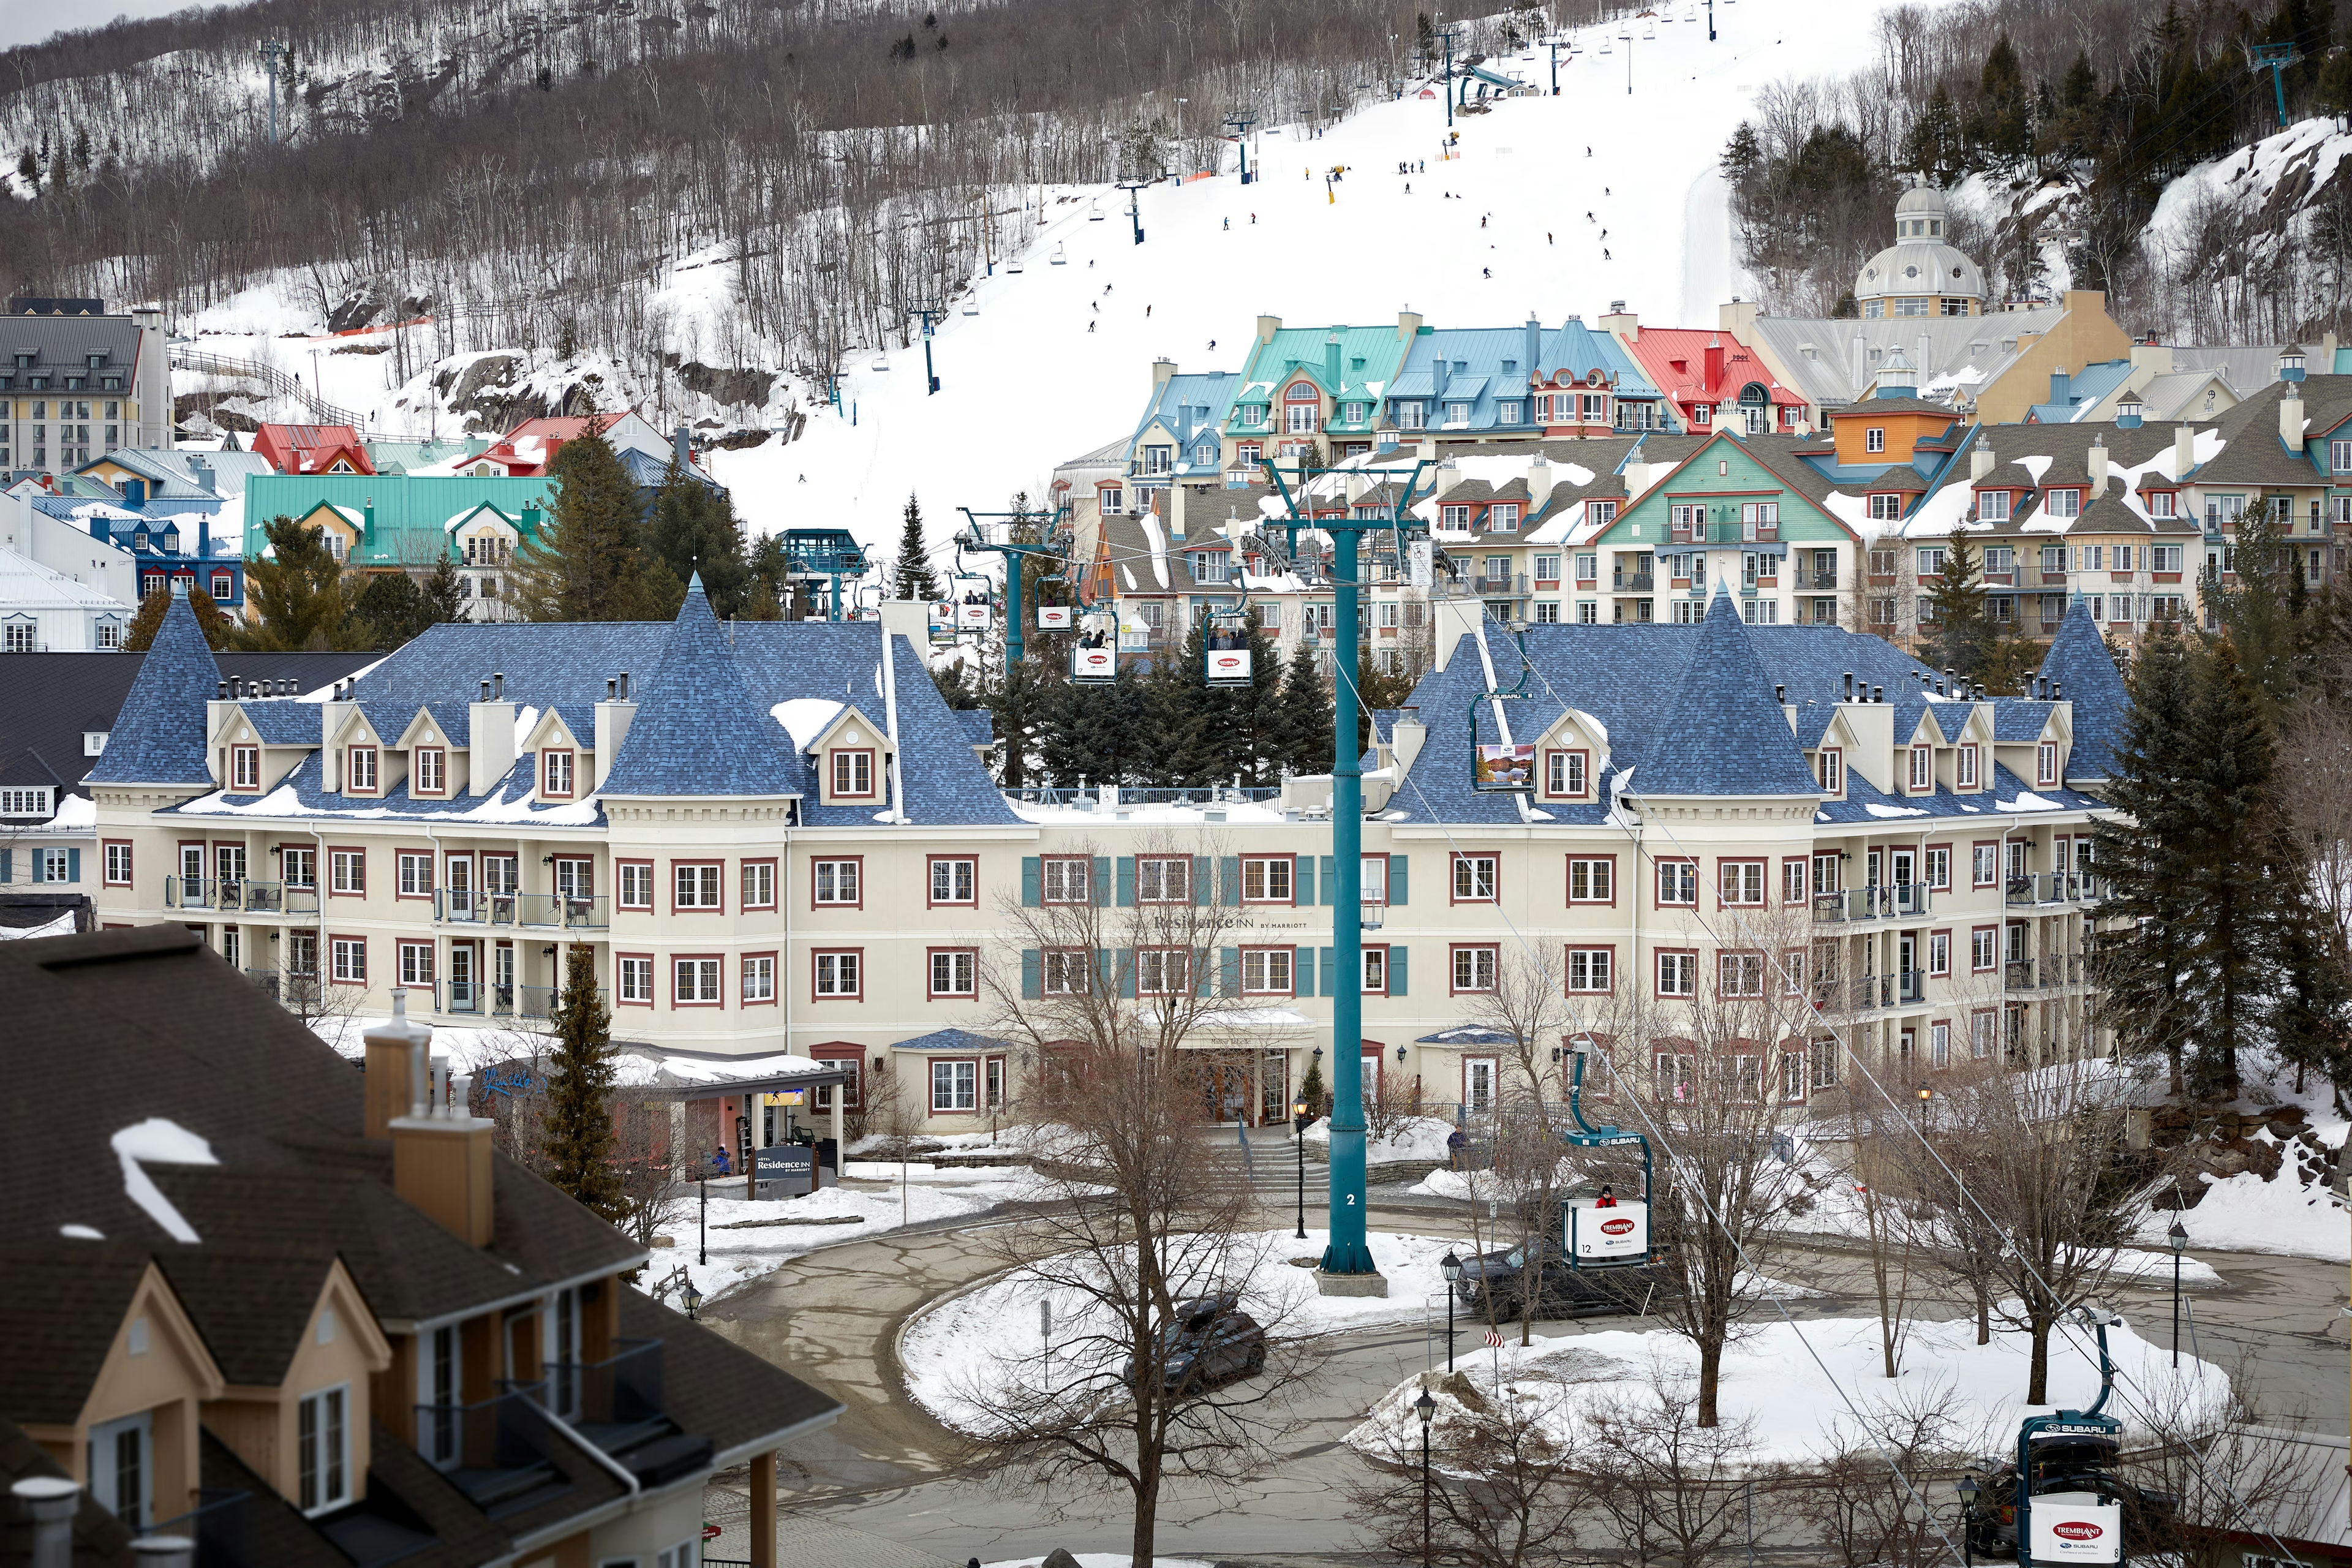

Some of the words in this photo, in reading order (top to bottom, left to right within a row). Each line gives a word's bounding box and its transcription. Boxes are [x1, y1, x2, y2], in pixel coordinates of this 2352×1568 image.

[1237, 918, 1253, 928] INN
[1346, 1194, 1355, 1205] 2
[1603, 1223, 1633, 1232] TREMBLANT
[1581, 1245, 1591, 1253] 12
[2062, 1425, 2106, 1433] SUBARU
[2057, 1527, 2100, 1539] TREMBLANT
[2114, 1548, 2119, 1558] 8
